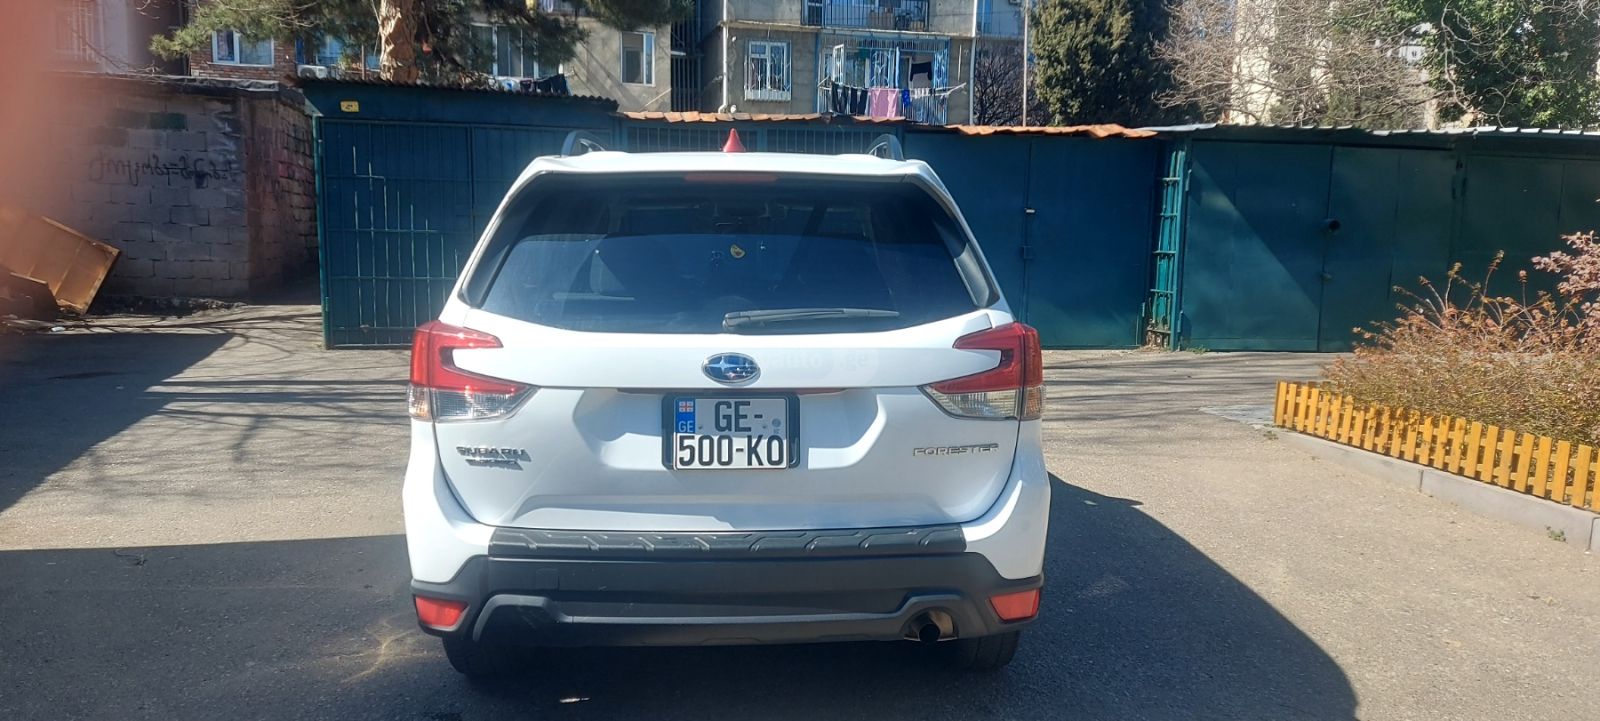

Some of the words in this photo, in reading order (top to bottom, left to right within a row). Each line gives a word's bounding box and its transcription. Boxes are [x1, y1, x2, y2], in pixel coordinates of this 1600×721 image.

[715, 401, 763, 432] GE-
[678, 420, 694, 433] GE
[456, 446, 530, 461] SUBARU
[679, 435, 784, 466] 500-KO
[913, 443, 999, 456] FORESTER
